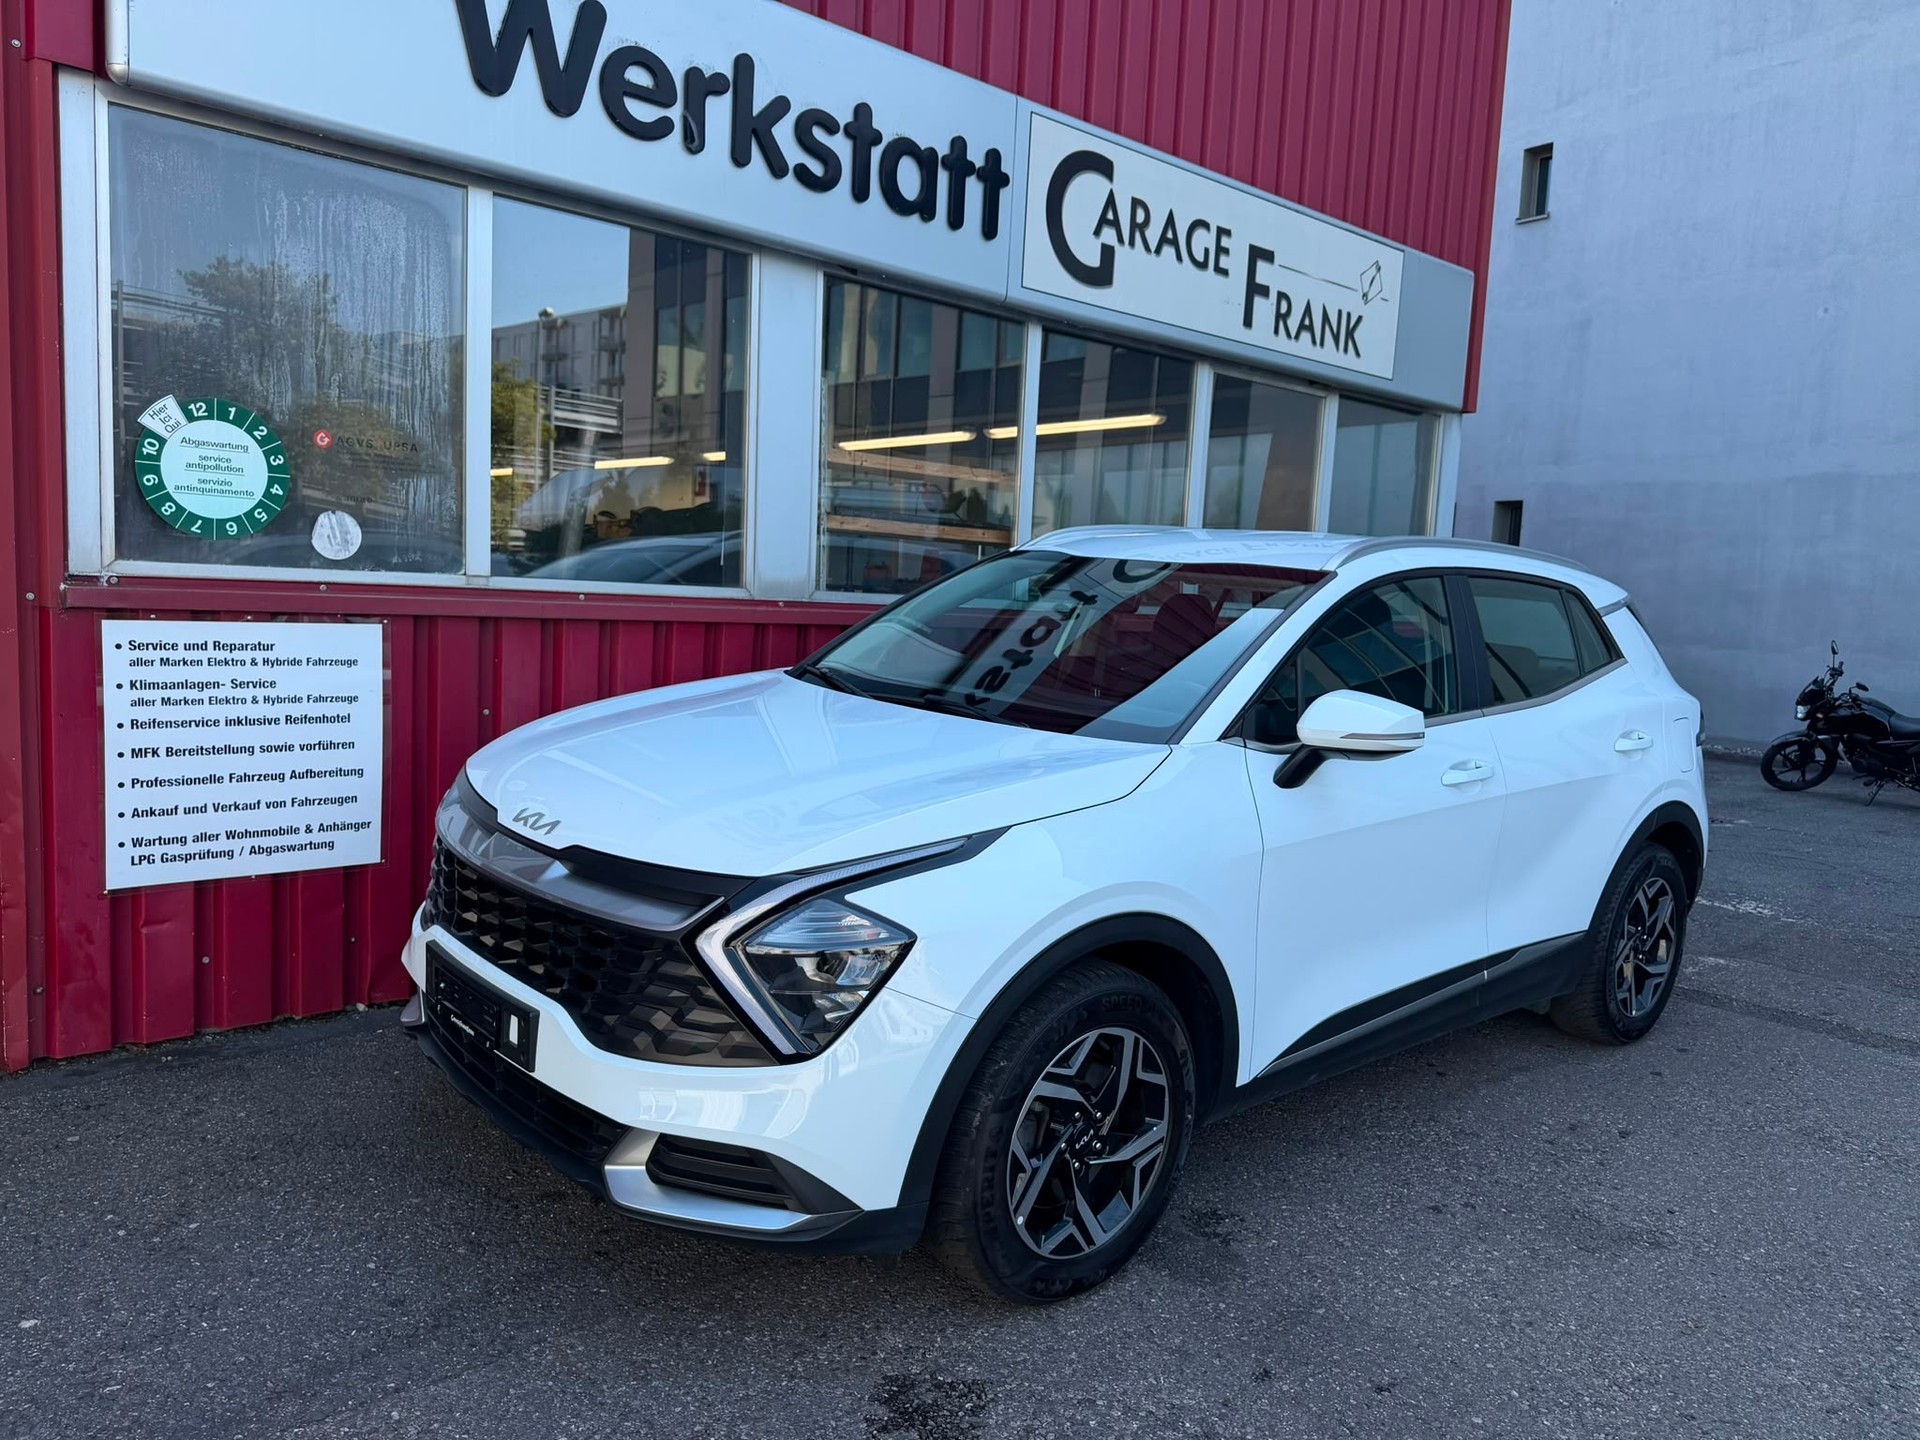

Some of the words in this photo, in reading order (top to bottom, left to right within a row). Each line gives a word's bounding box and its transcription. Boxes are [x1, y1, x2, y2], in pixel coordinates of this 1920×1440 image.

[461, 0, 1010, 241] Werkstatt
[1045, 149, 1232, 288] GARAGE
[1243, 243, 1364, 358] FRANK
[148, 404, 169, 420] Hier
[188, 402, 208, 417] 12
[228, 407, 237, 420] 1
[159, 411, 172, 424] Ici
[165, 418, 181, 434] Qui
[253, 426, 268, 439] 2
[141, 438, 159, 455] 10
[180, 436, 249, 452] Abgaswartung
[198, 454, 232, 464] service
[270, 454, 284, 466] 3
[185, 461, 244, 474] antipollution
[143, 474, 158, 486] 9
[197, 478, 233, 487] servizio
[174, 484, 255, 497] antinquinamento
[270, 484, 284, 496] 4
[161, 502, 176, 516] 8
[254, 508, 268, 522] 5
[190, 519, 203, 533] 7
[225, 521, 238, 535] 6
[129, 640, 178, 651] Service
[184, 641, 207, 651] und
[213, 641, 275, 653] Reparatur
[129, 658, 155, 666] aller
[160, 658, 203, 666] Marken
[208, 658, 246, 666] Elektro
[250, 658, 258, 666] &
[263, 658, 302, 668] Hybride
[307, 658, 358, 667] Fahrzeuge
[130, 679, 225, 692] Klimaanlagen-
[231, 679, 276, 689] Service
[131, 698, 156, 707] aller
[161, 697, 204, 706] Marken
[209, 696, 246, 705] Elektro
[251, 696, 259, 704] &
[264, 695, 303, 706] Hybride
[307, 695, 358, 704] Fahrzeuge
[131, 717, 220, 729] Reifenservice
[225, 716, 280, 726] inklusive
[285, 713, 350, 724] Reifenhotel
[131, 747, 160, 758] MFK
[166, 744, 254, 757] Bereitstellung
[259, 742, 294, 753] sowie
[299, 740, 354, 751] vorführen
[132, 774, 224, 788] Professionelle
[229, 773, 285, 783] Fahrzeug
[290, 768, 363, 779] Aufbereitung
[132, 805, 178, 818] Ankauf
[184, 803, 207, 815] und
[213, 800, 260, 812] Verkauf
[265, 801, 286, 809] von
[292, 796, 357, 807] Fahrzeugen
[132, 836, 187, 848] Wartung
[192, 832, 221, 843] aller
[225, 826, 300, 840] Wohnmobile
[305, 824, 313, 834] &
[318, 821, 371, 832] Anhänger
[131, 854, 155, 866] LPG
[161, 849, 234, 863] Gasprüfung
[239, 847, 244, 856] /
[249, 841, 334, 856] Abgaswartung
